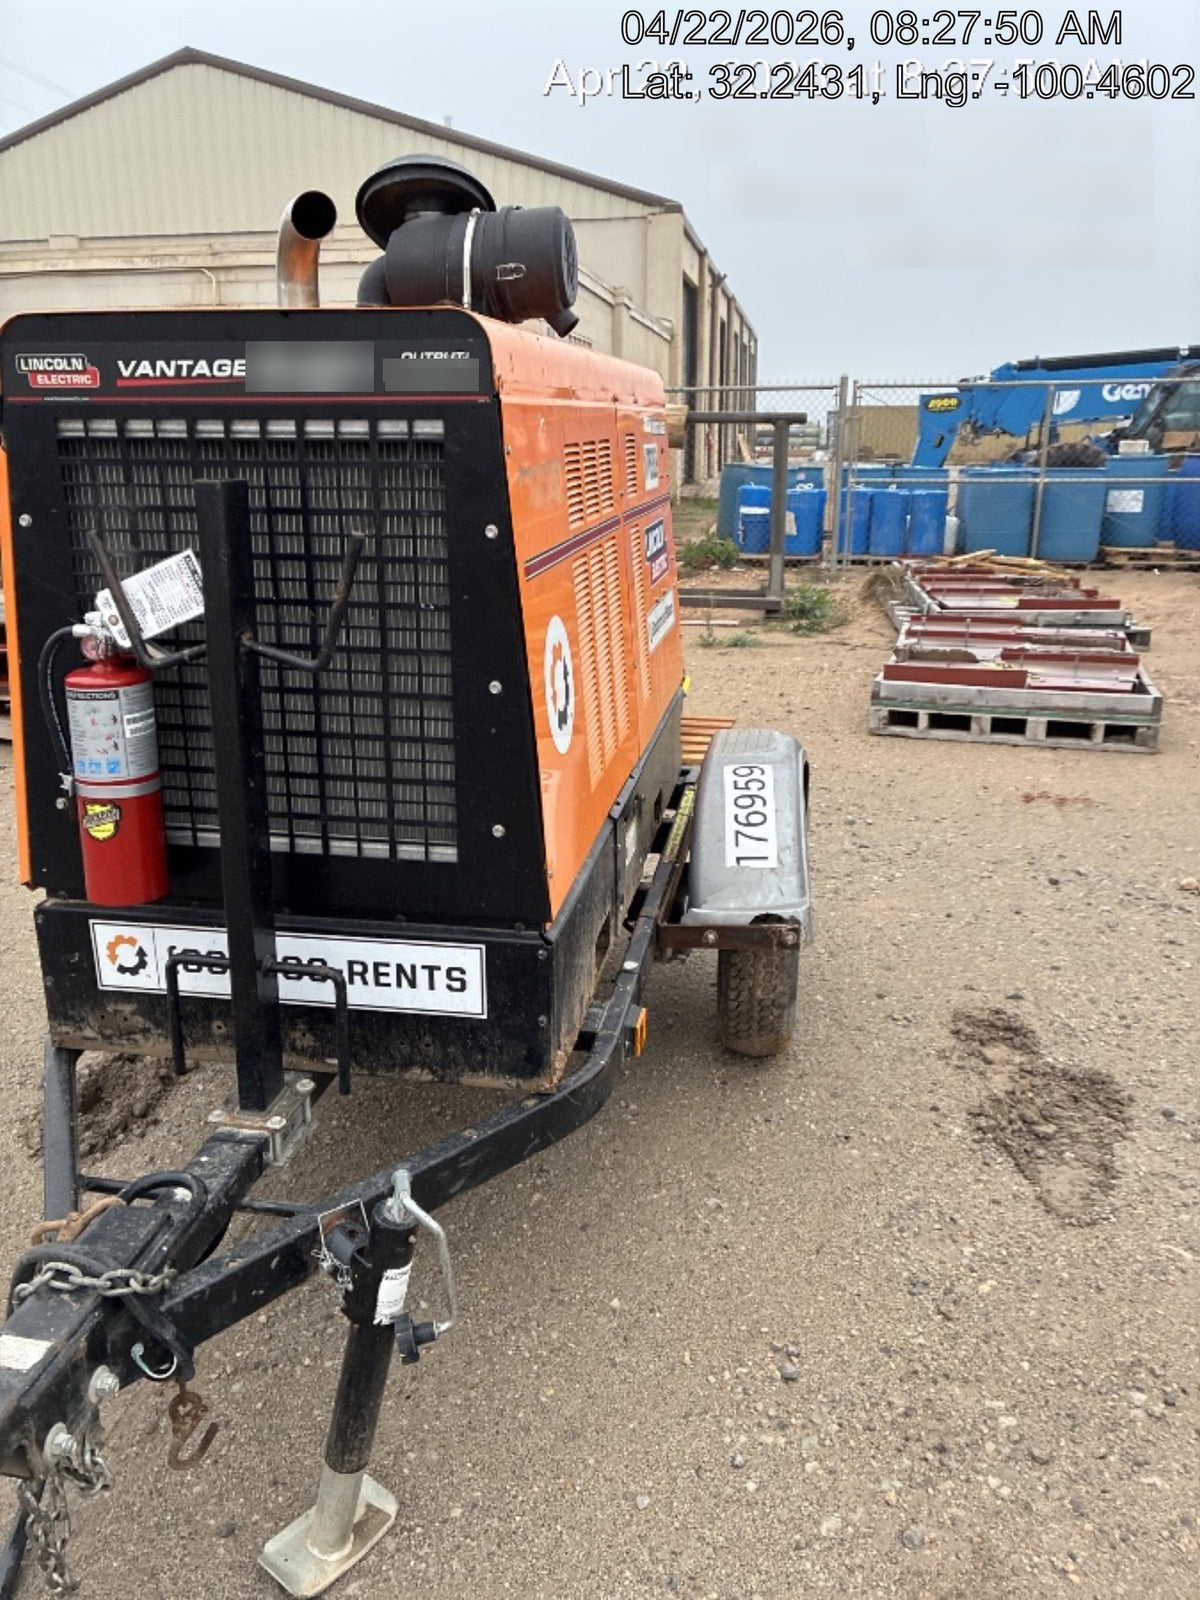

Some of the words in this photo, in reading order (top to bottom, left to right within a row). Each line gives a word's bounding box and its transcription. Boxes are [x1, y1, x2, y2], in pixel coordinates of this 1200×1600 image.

[20, 358, 83, 371] LINCOLN
[117, 359, 246, 378] VANTAGE
[37, 374, 92, 385] ELECTRIC
[732, 765, 769, 866] 176959
